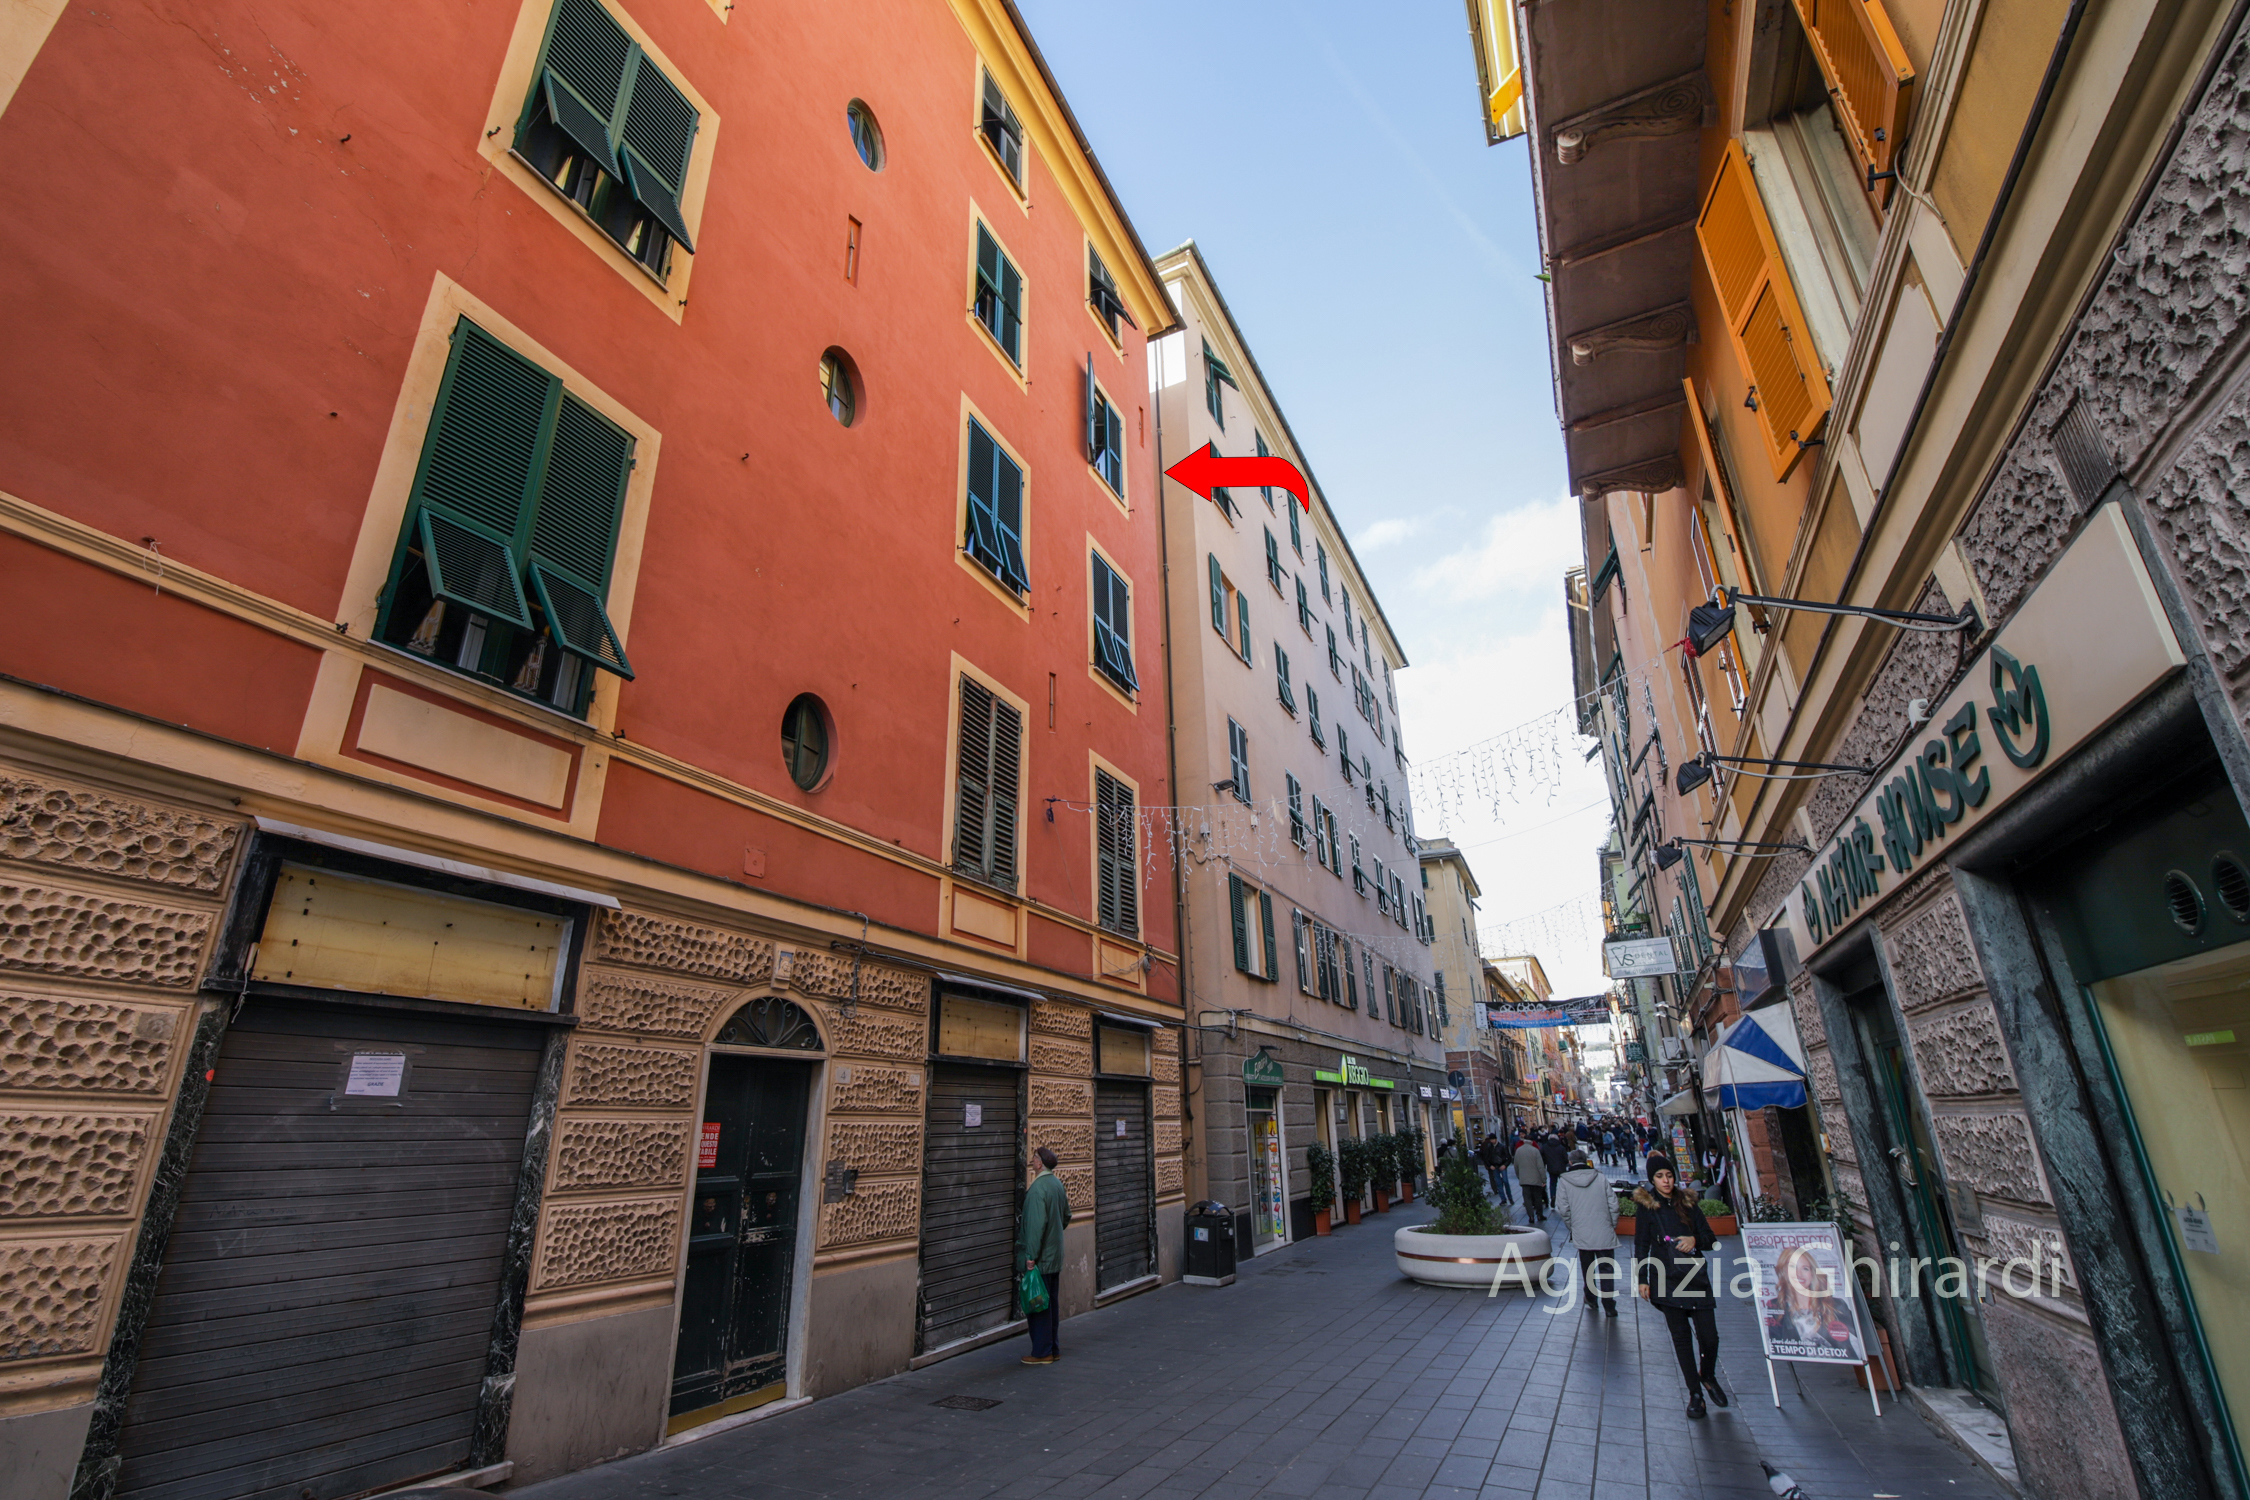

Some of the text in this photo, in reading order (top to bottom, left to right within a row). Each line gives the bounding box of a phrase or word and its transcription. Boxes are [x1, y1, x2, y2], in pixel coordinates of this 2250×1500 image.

[1816, 701, 1990, 935] NATUR HOUSE
[1634, 950, 1669, 959] DENTAL
[1774, 1345, 1806, 1355] TEMPO
[1806, 1347, 1816, 1355] DI
[1817, 1347, 1849, 1358] DETOX
